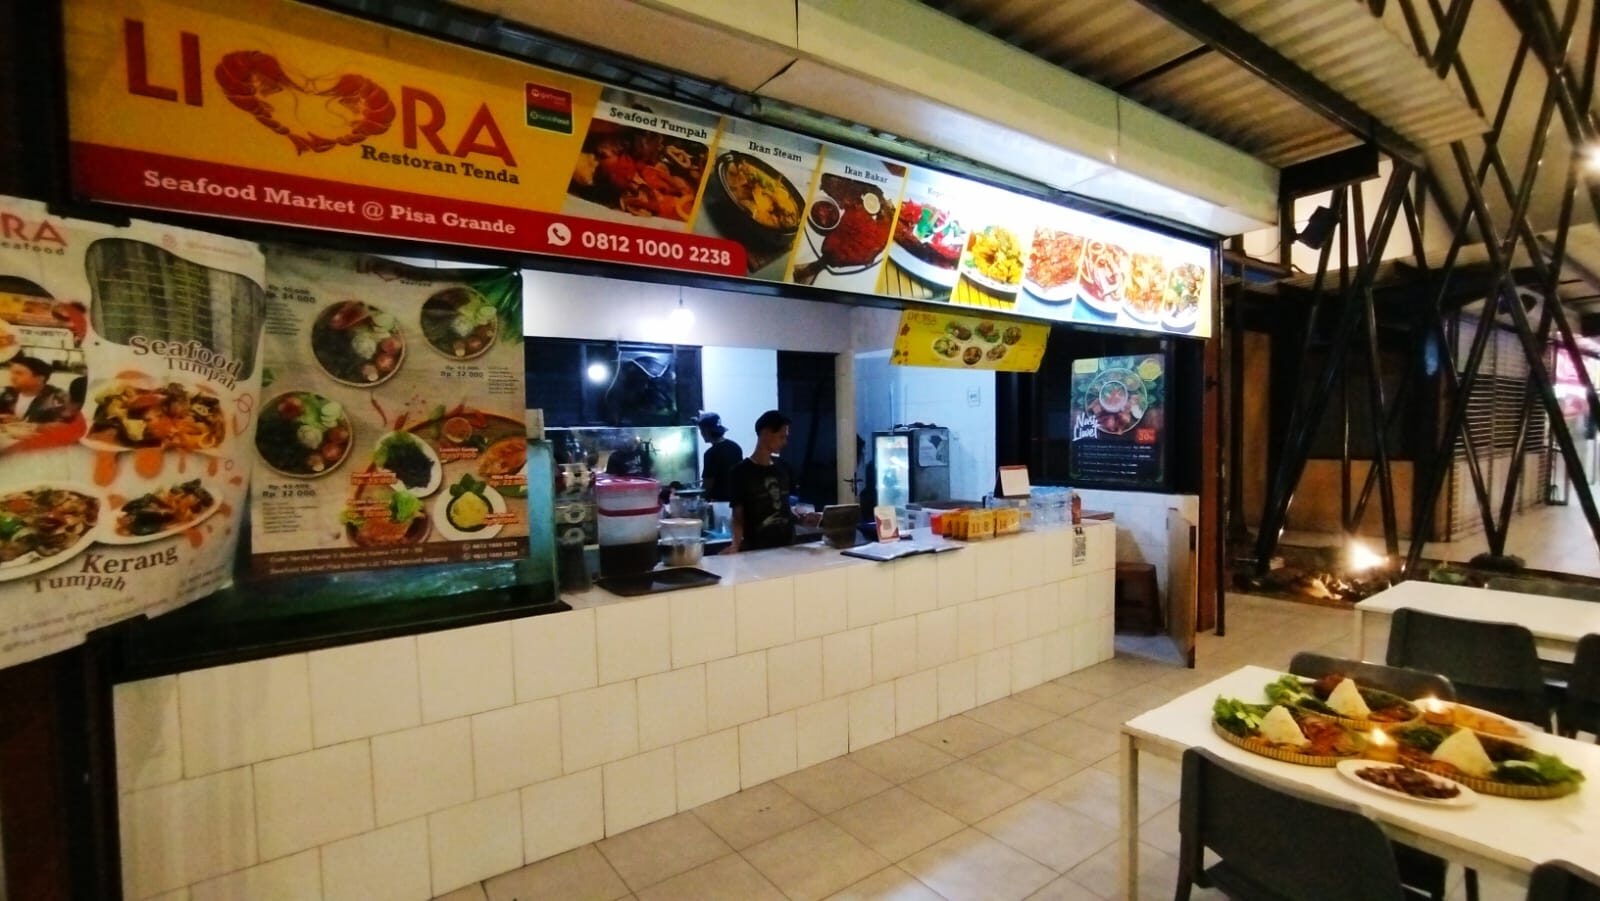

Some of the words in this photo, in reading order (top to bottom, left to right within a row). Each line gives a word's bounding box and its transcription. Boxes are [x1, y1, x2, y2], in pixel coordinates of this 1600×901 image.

[609, 107, 658, 129] Seafood
[660, 119, 708, 140] Tumpah
[361, 145, 458, 175] Restoran
[461, 162, 519, 186] Tenda
[748, 141, 771, 155] Ikan
[773, 147, 803, 163] Steam
[844, 165, 863, 178] Ikan
[865, 170, 889, 184] Bakar
[143, 169, 258, 201] Seafood
[264, 185, 356, 216] Market
[361, 201, 386, 221] @
[390, 204, 437, 226] Pisa
[442, 211, 516, 236] Grande
[0, 241, 65, 256] eafood
[582, 231, 630, 253] 0812
[636, 238, 684, 260] 1000
[689, 246, 731, 266] 2238
[130, 336, 242, 376] Seafood
[165, 356, 237, 392] Tumpah
[80, 544, 179, 574] Kerang
[32, 573, 127, 594] Tumpah
